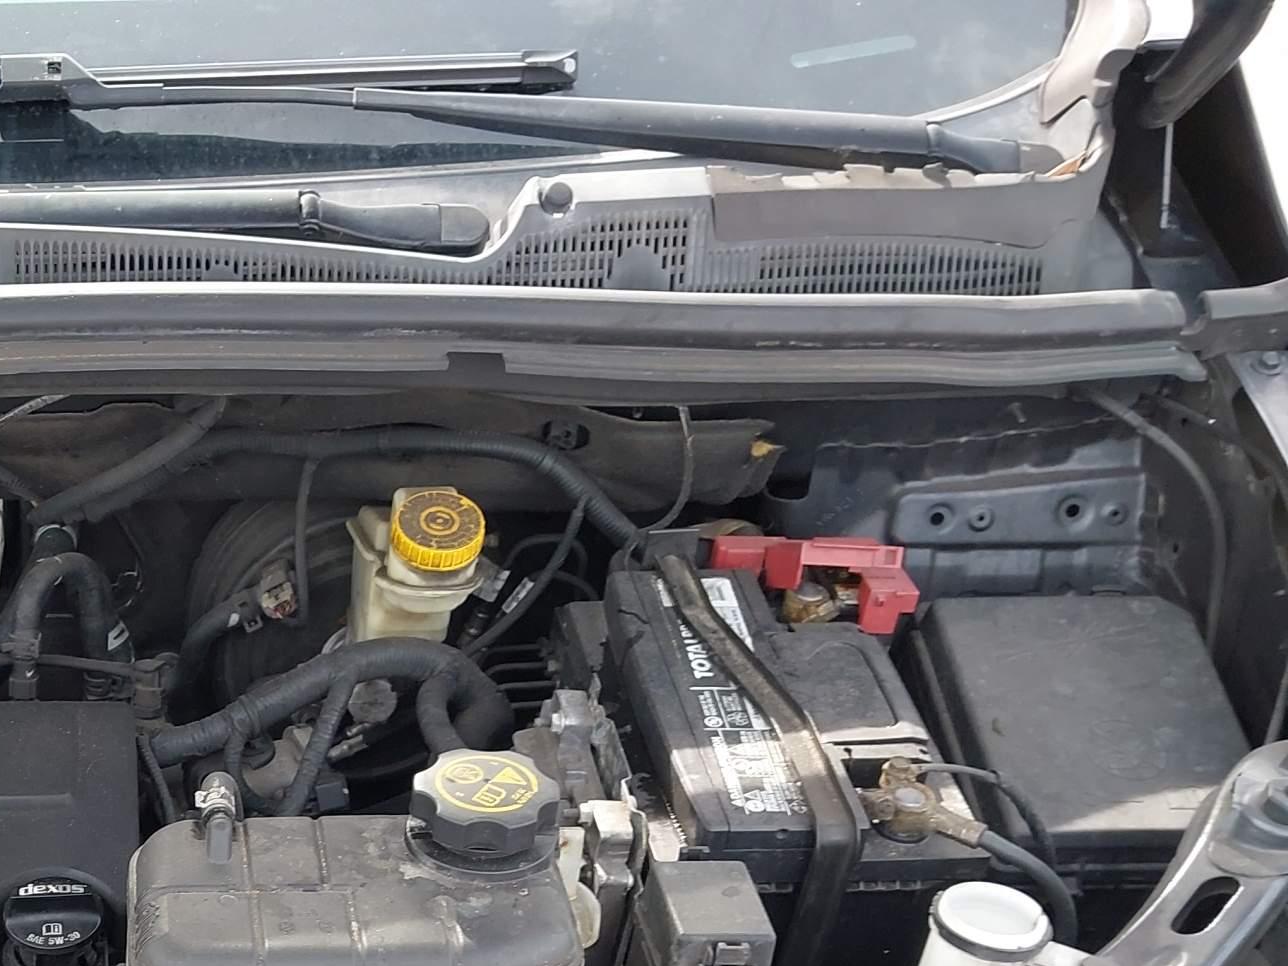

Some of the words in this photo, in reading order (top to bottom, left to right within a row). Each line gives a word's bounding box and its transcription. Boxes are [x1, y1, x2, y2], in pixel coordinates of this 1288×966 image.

[18, 883, 88, 896] dexos
[26, 933, 46, 945] SAE
[47, 931, 81, 945] 5W-30
